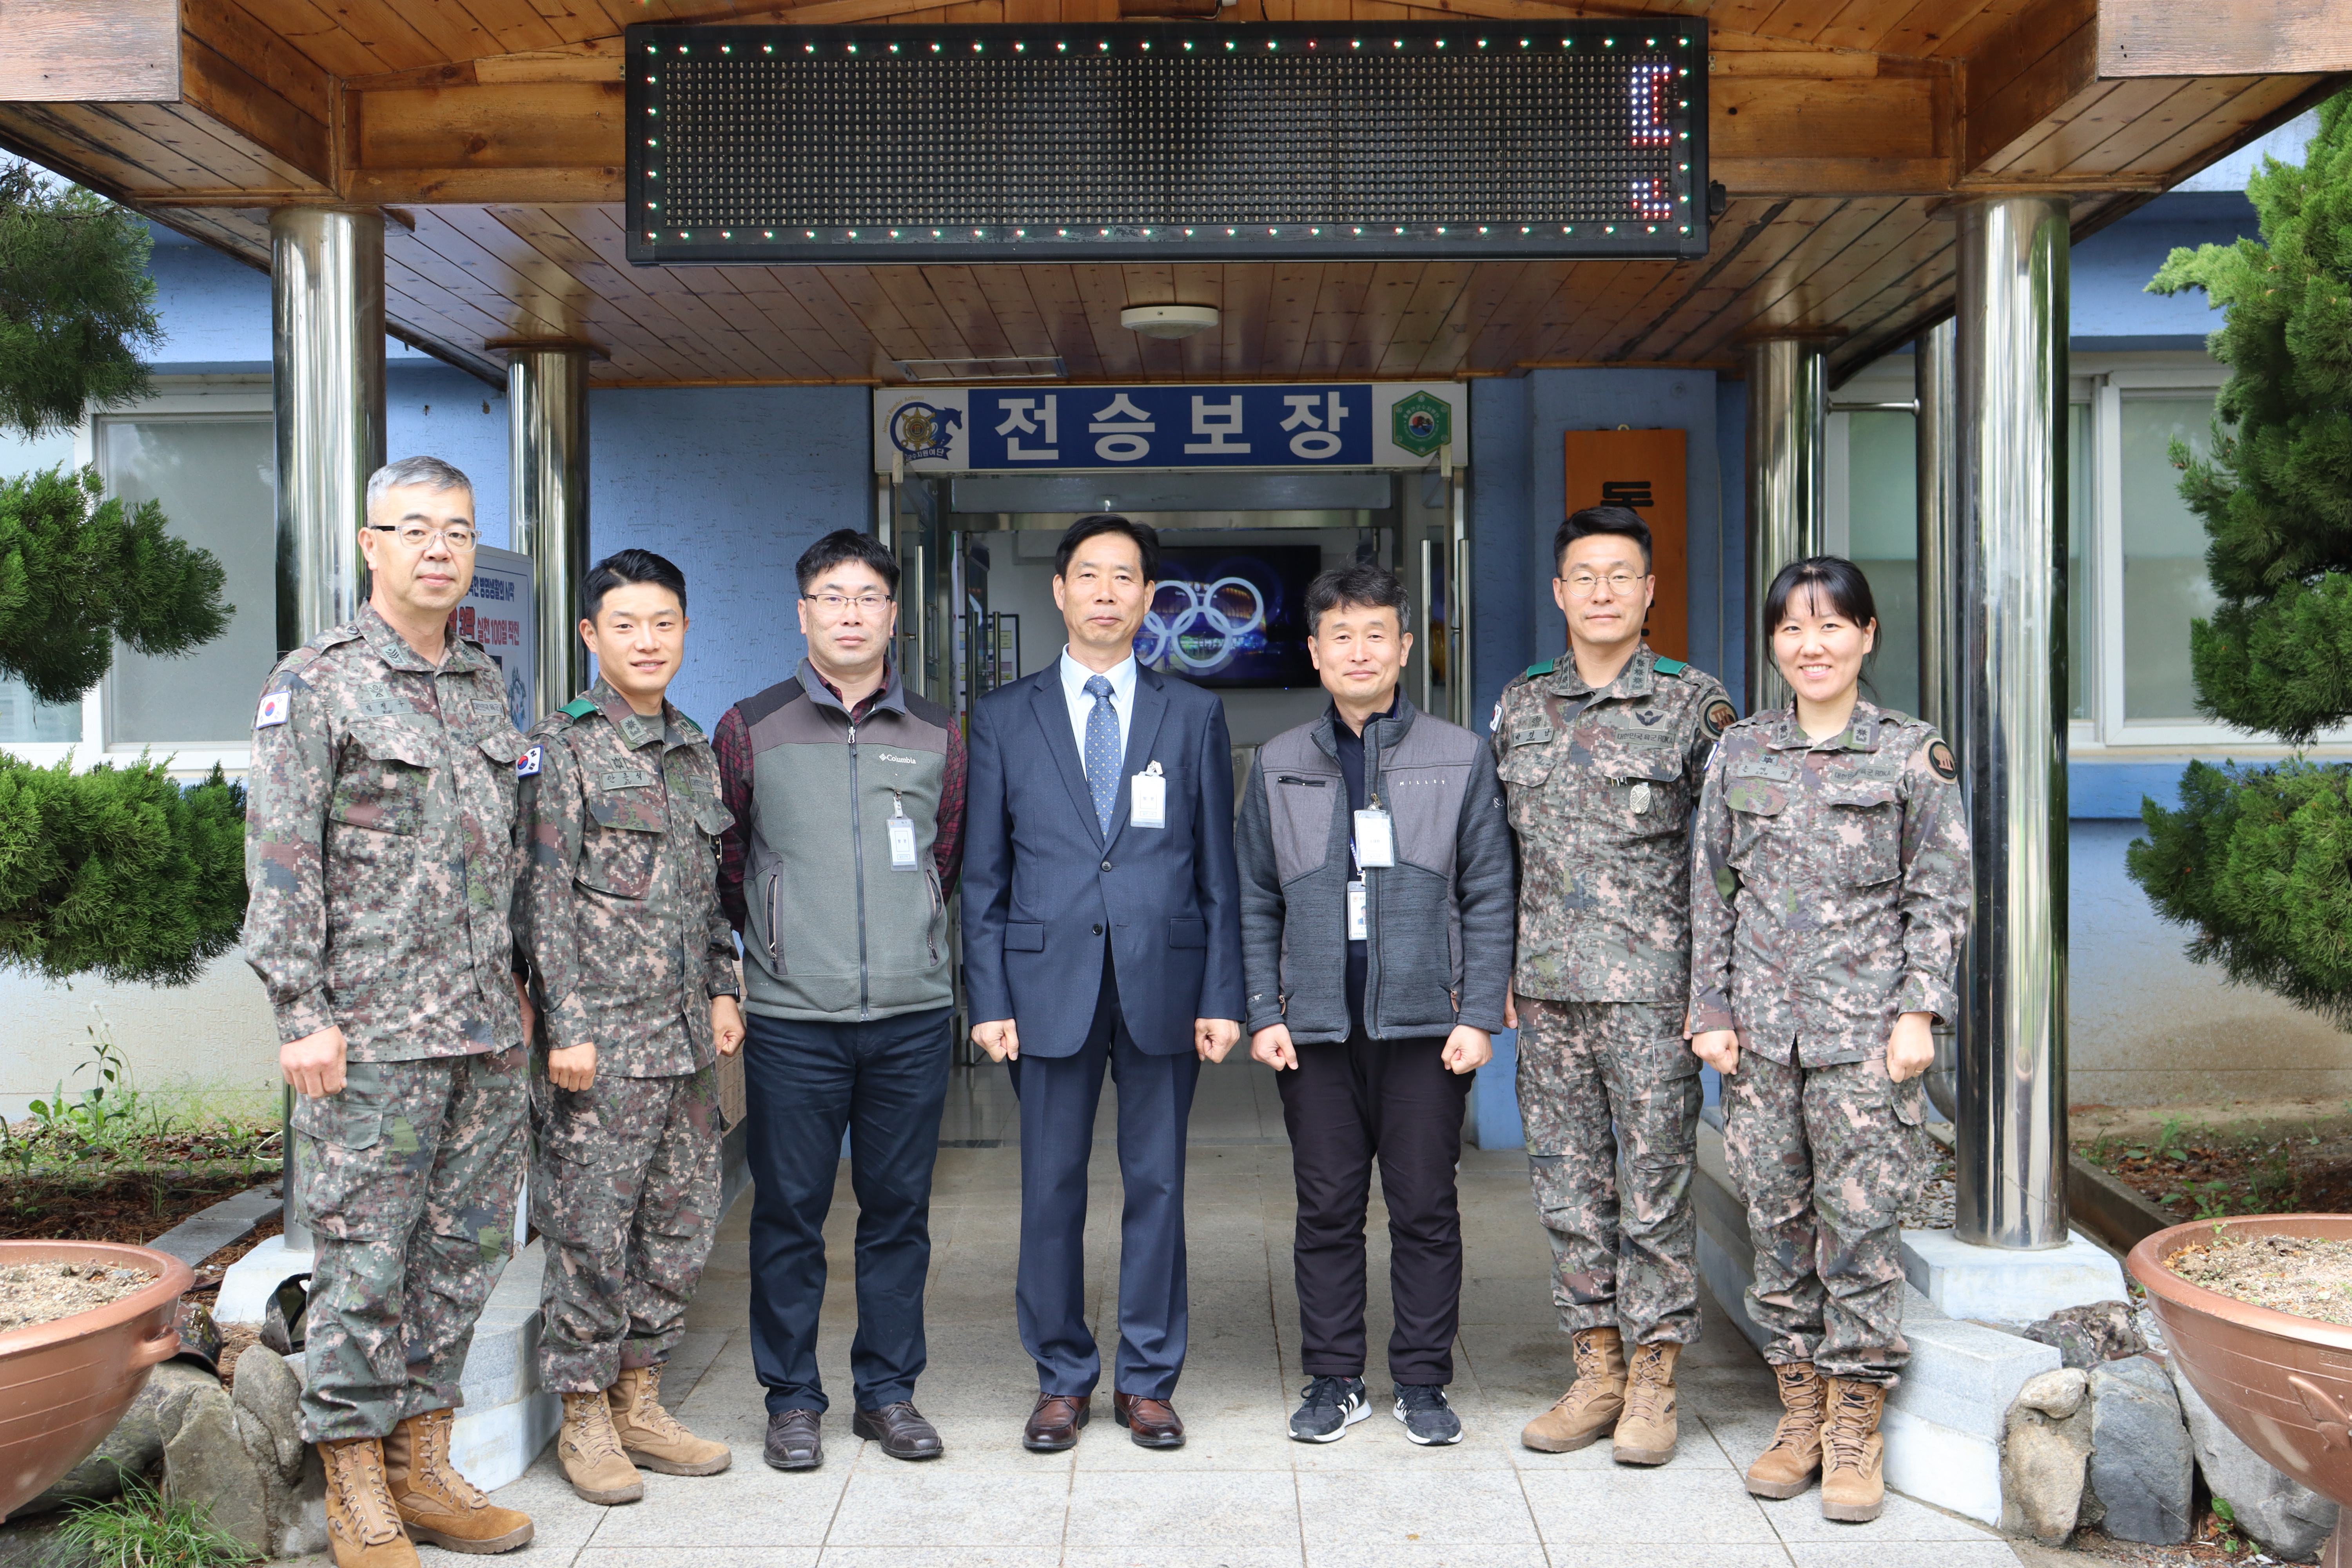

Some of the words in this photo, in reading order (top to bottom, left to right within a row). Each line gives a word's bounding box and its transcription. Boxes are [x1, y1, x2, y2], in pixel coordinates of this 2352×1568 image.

[995, 391, 1349, 461] 전승보장
[479, 577, 505, 601] 병영생활의
[505, 581, 514, 602] 시작
[491, 619, 507, 645] 100일
[1658, 735, 1673, 744] ROKA
[887, 754, 916, 764] Columbia
